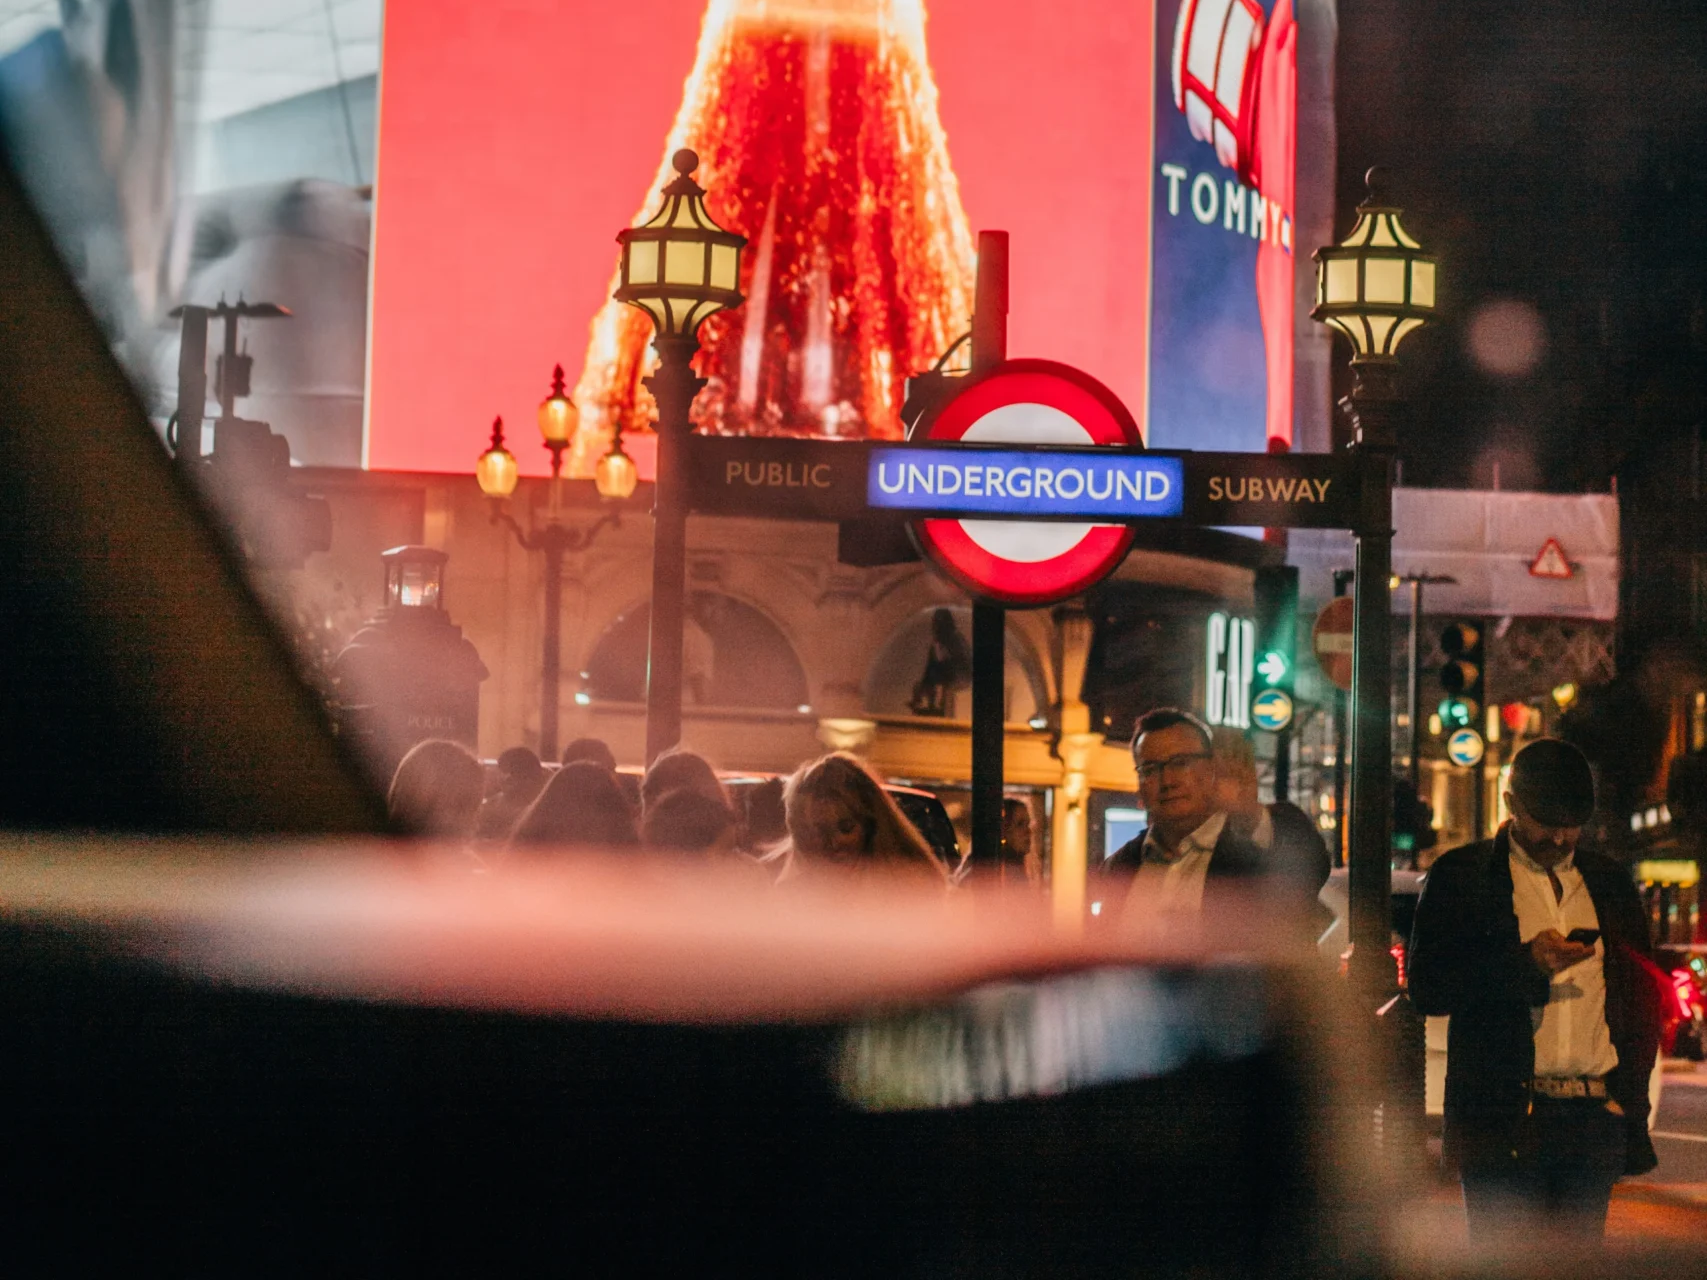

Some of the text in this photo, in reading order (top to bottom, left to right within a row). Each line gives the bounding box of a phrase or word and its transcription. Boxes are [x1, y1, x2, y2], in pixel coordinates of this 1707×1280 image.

[1161, 162, 1281, 248] TOMMY
[726, 461, 1331, 503] PUBLIC UNDERGROUND SUBWAY
[1206, 612, 1255, 729] GAP
